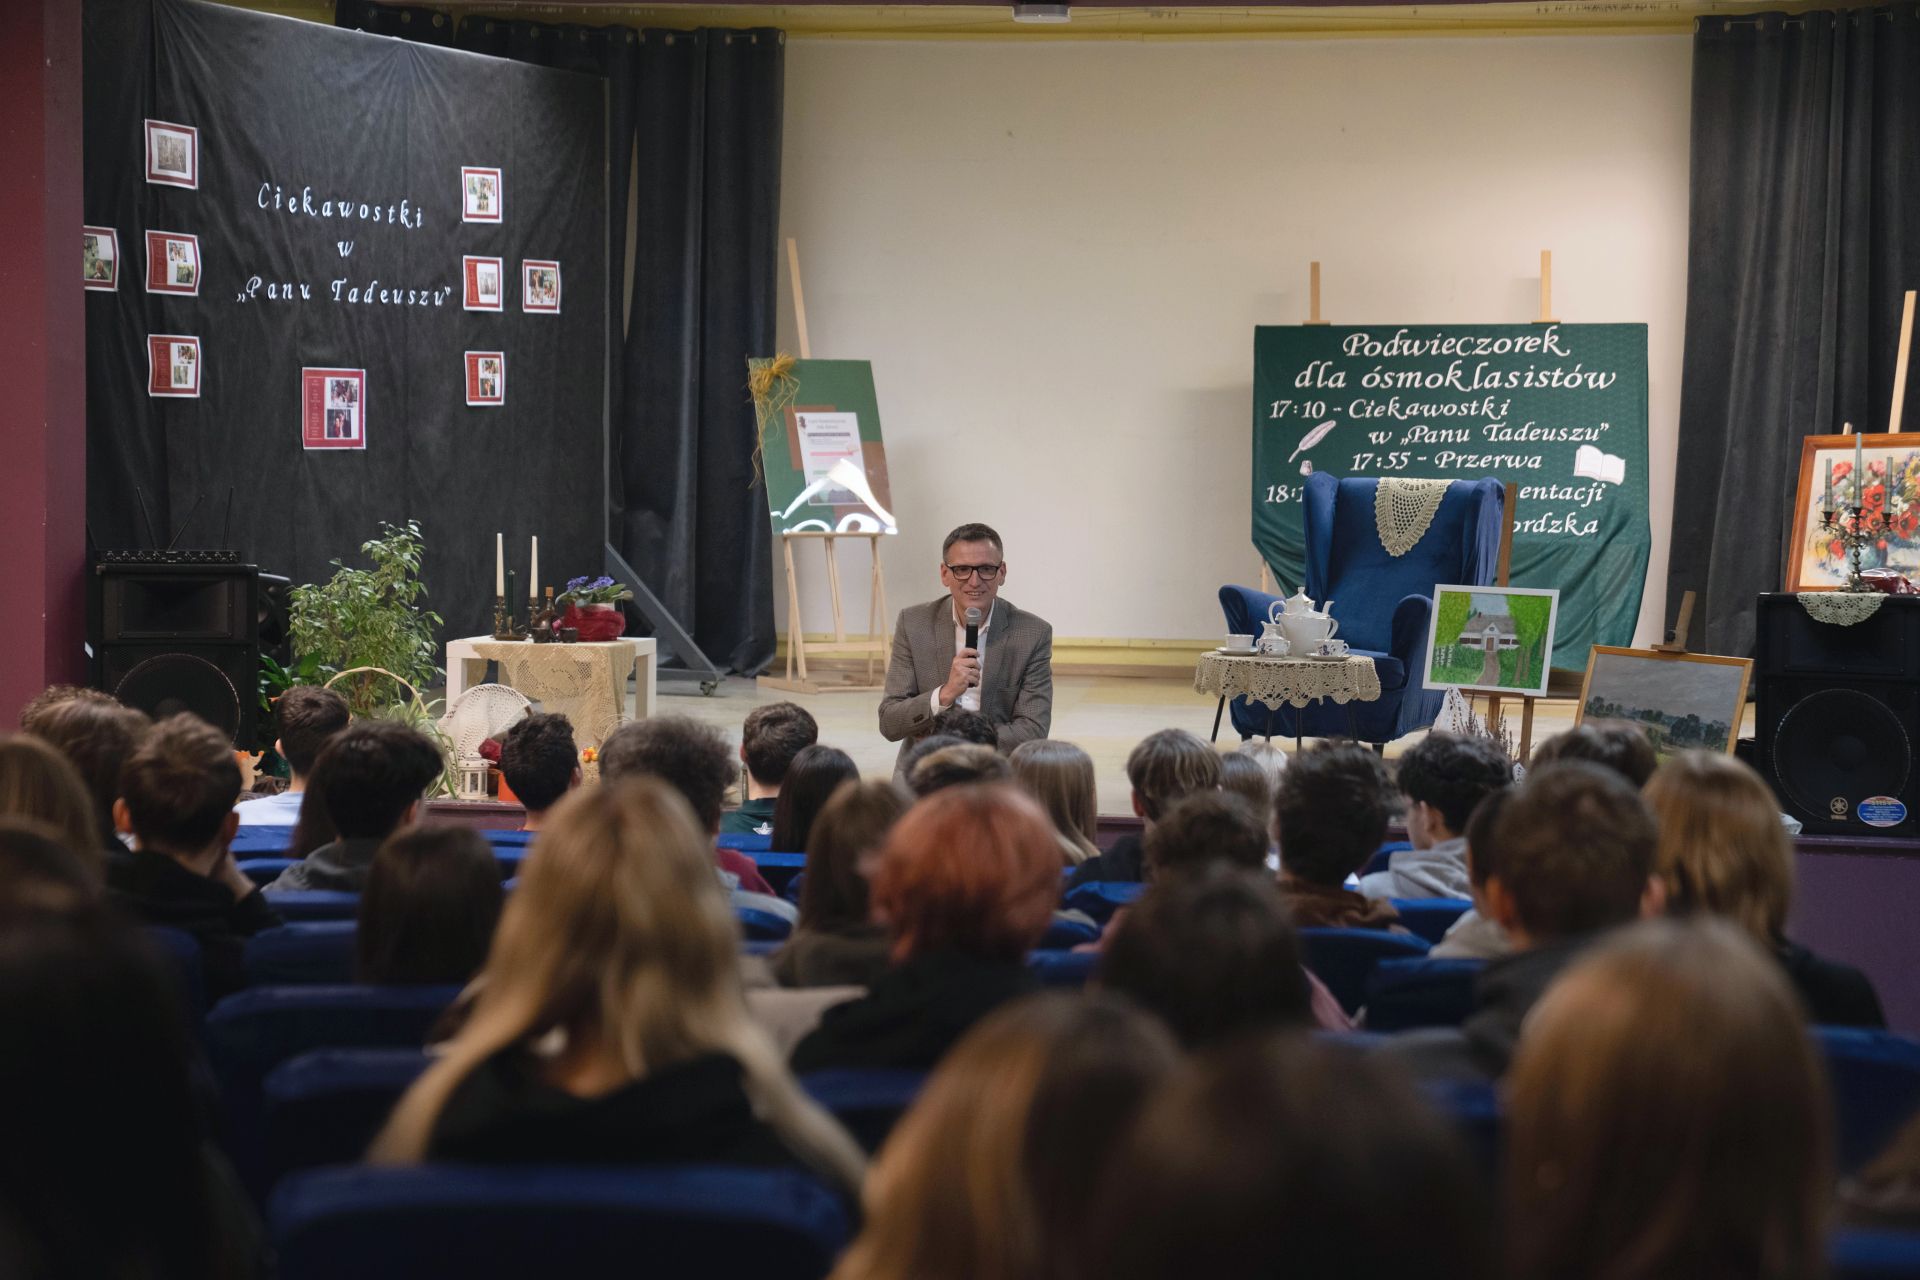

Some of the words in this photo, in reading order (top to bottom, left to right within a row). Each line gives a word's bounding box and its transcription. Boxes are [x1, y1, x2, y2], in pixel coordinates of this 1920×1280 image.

[257, 182, 423, 229] Ciekawostki
[337, 240, 354, 258] w
[1342, 325, 1571, 357] Podwieczorek
[1294, 360, 1347, 389] dla
[1361, 360, 1616, 392] ósmoklasistów
[1269, 400, 1326, 418] 17:10
[1348, 396, 1511, 420] Ciekawostki
[1368, 431, 1393, 445] w
[1400, 425, 1471, 445] „Panu
[1482, 421, 1610, 443] Tadeuszu”
[1350, 452, 1410, 471] 17:55
[1434, 451, 1543, 470] Przerwa
[1265, 485, 1304, 503] 18:1
[1516, 482, 1606, 507] entacji
[1512, 511, 1599, 536] ordzka
